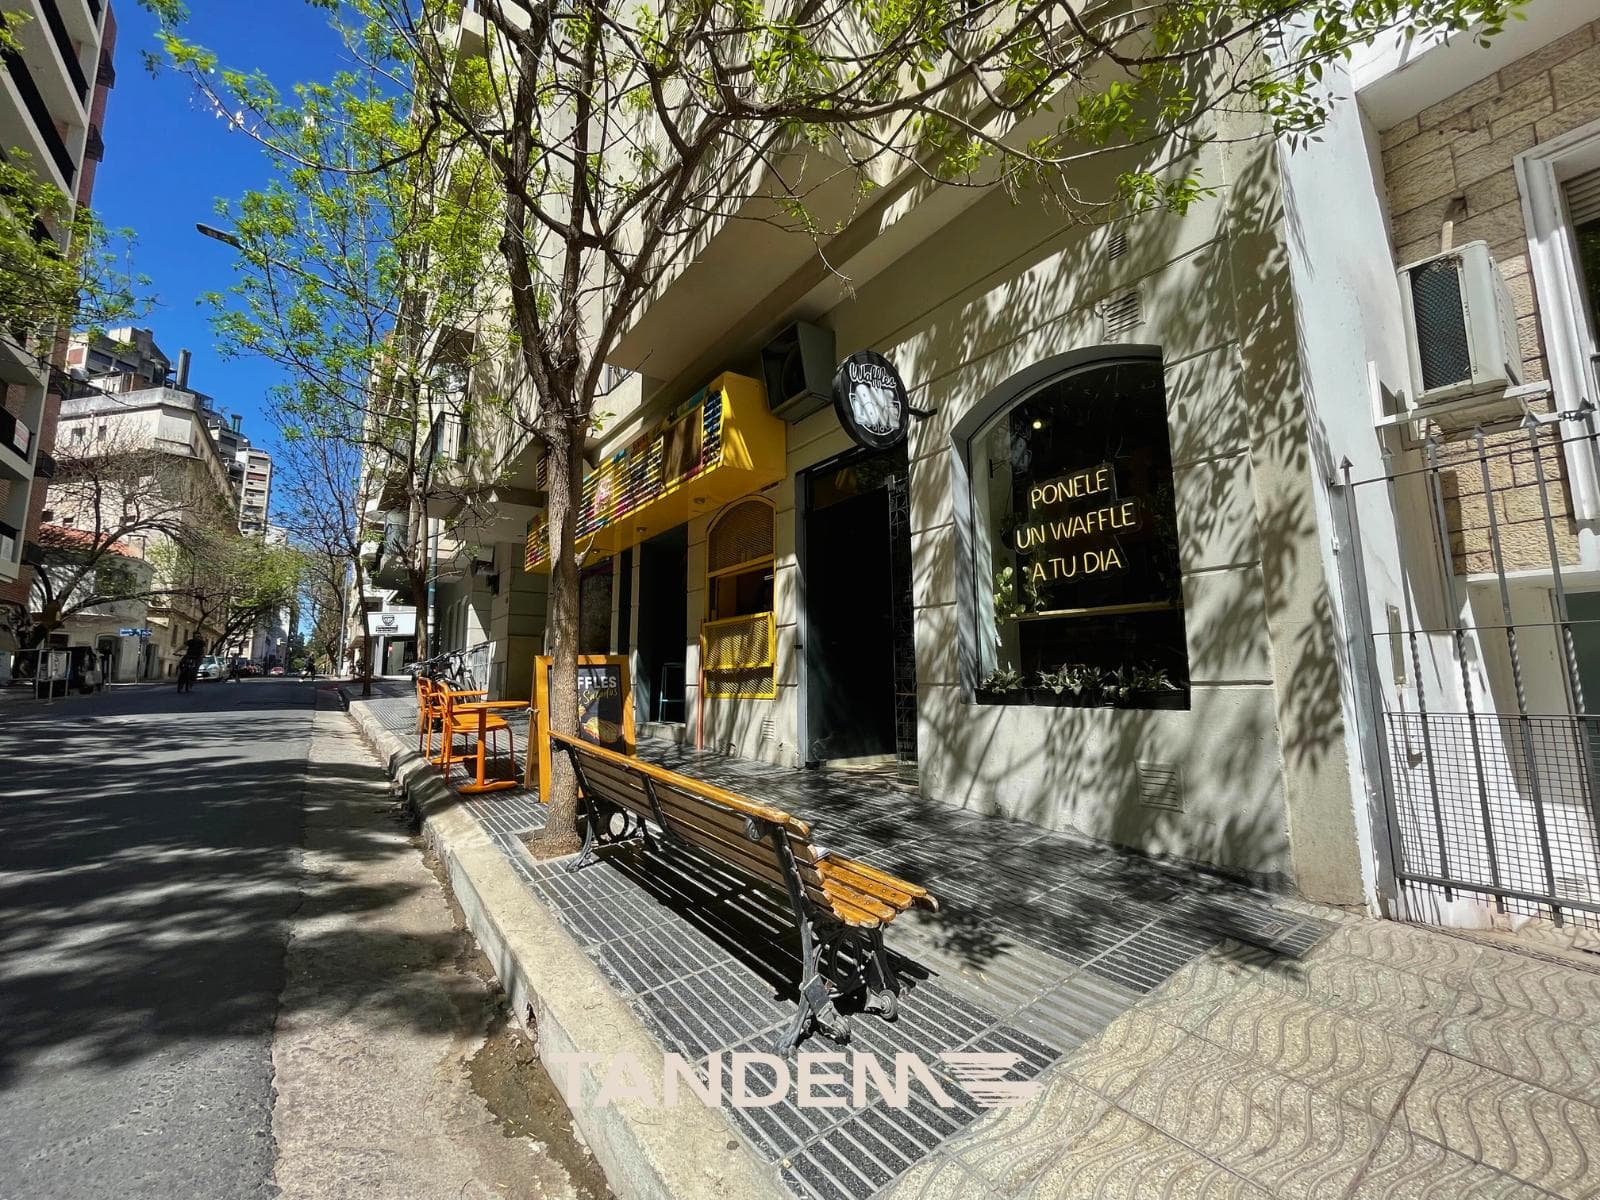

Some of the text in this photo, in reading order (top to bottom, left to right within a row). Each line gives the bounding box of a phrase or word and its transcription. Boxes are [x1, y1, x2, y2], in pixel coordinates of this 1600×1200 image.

[849, 362, 897, 389] Waffles
[1031, 469, 1110, 509] PONELE
[1017, 503, 1136, 549] UN WAFFLE
[1032, 548, 1122, 582] A TU DIA
[578, 676, 617, 690] FFLES
